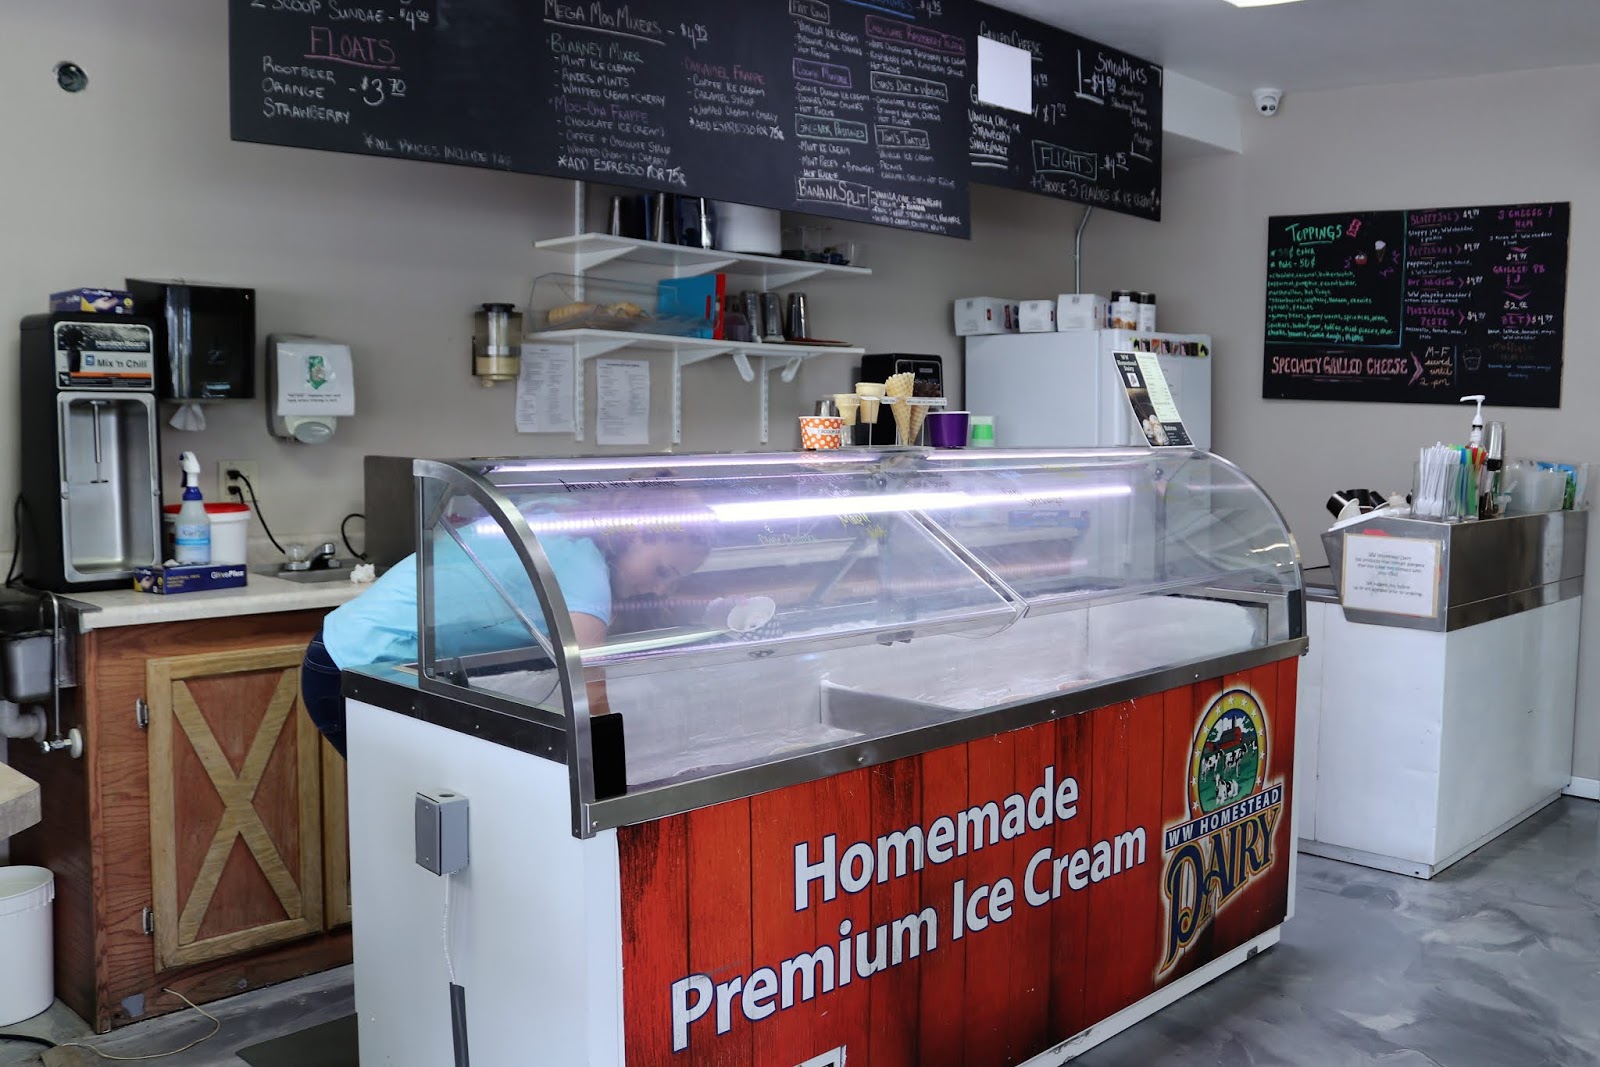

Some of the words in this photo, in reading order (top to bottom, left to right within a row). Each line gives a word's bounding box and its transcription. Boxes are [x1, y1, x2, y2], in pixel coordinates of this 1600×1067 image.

[329, 0, 385, 23] SUNDAE
[544, 0, 585, 21] MEGA
[617, 5, 662, 34] MIXERS
[310, 26, 396, 65] FLOATS
[262, 77, 325, 100] ORANGE
[597, 75, 630, 88] MINTS
[263, 97, 350, 125] STRAWBERRY
[593, 158, 644, 176] ESPRESSO
[1040, 146, 1094, 175] FLIGHTS
[798, 177, 839, 201] BANANA
[838, 180, 867, 208] SPLIT
[1285, 222, 1343, 242] TOPPINGS
[97, 359, 113, 368] Mix
[126, 359, 147, 369] Chill
[1272, 355, 1322, 375] SPECIALTY
[1323, 355, 1363, 376] GRILLED
[1366, 356, 1409, 376] CHEESE
[1168, 823, 1194, 848] WW
[1199, 787, 1280, 837] HOMESTEAD
[794, 764, 1080, 912] Homemade
[1160, 805, 1281, 975] DAIRY
[671, 905, 939, 1054] Premium
[951, 875, 1016, 941] Ice
[1023, 825, 1147, 909] Cream
